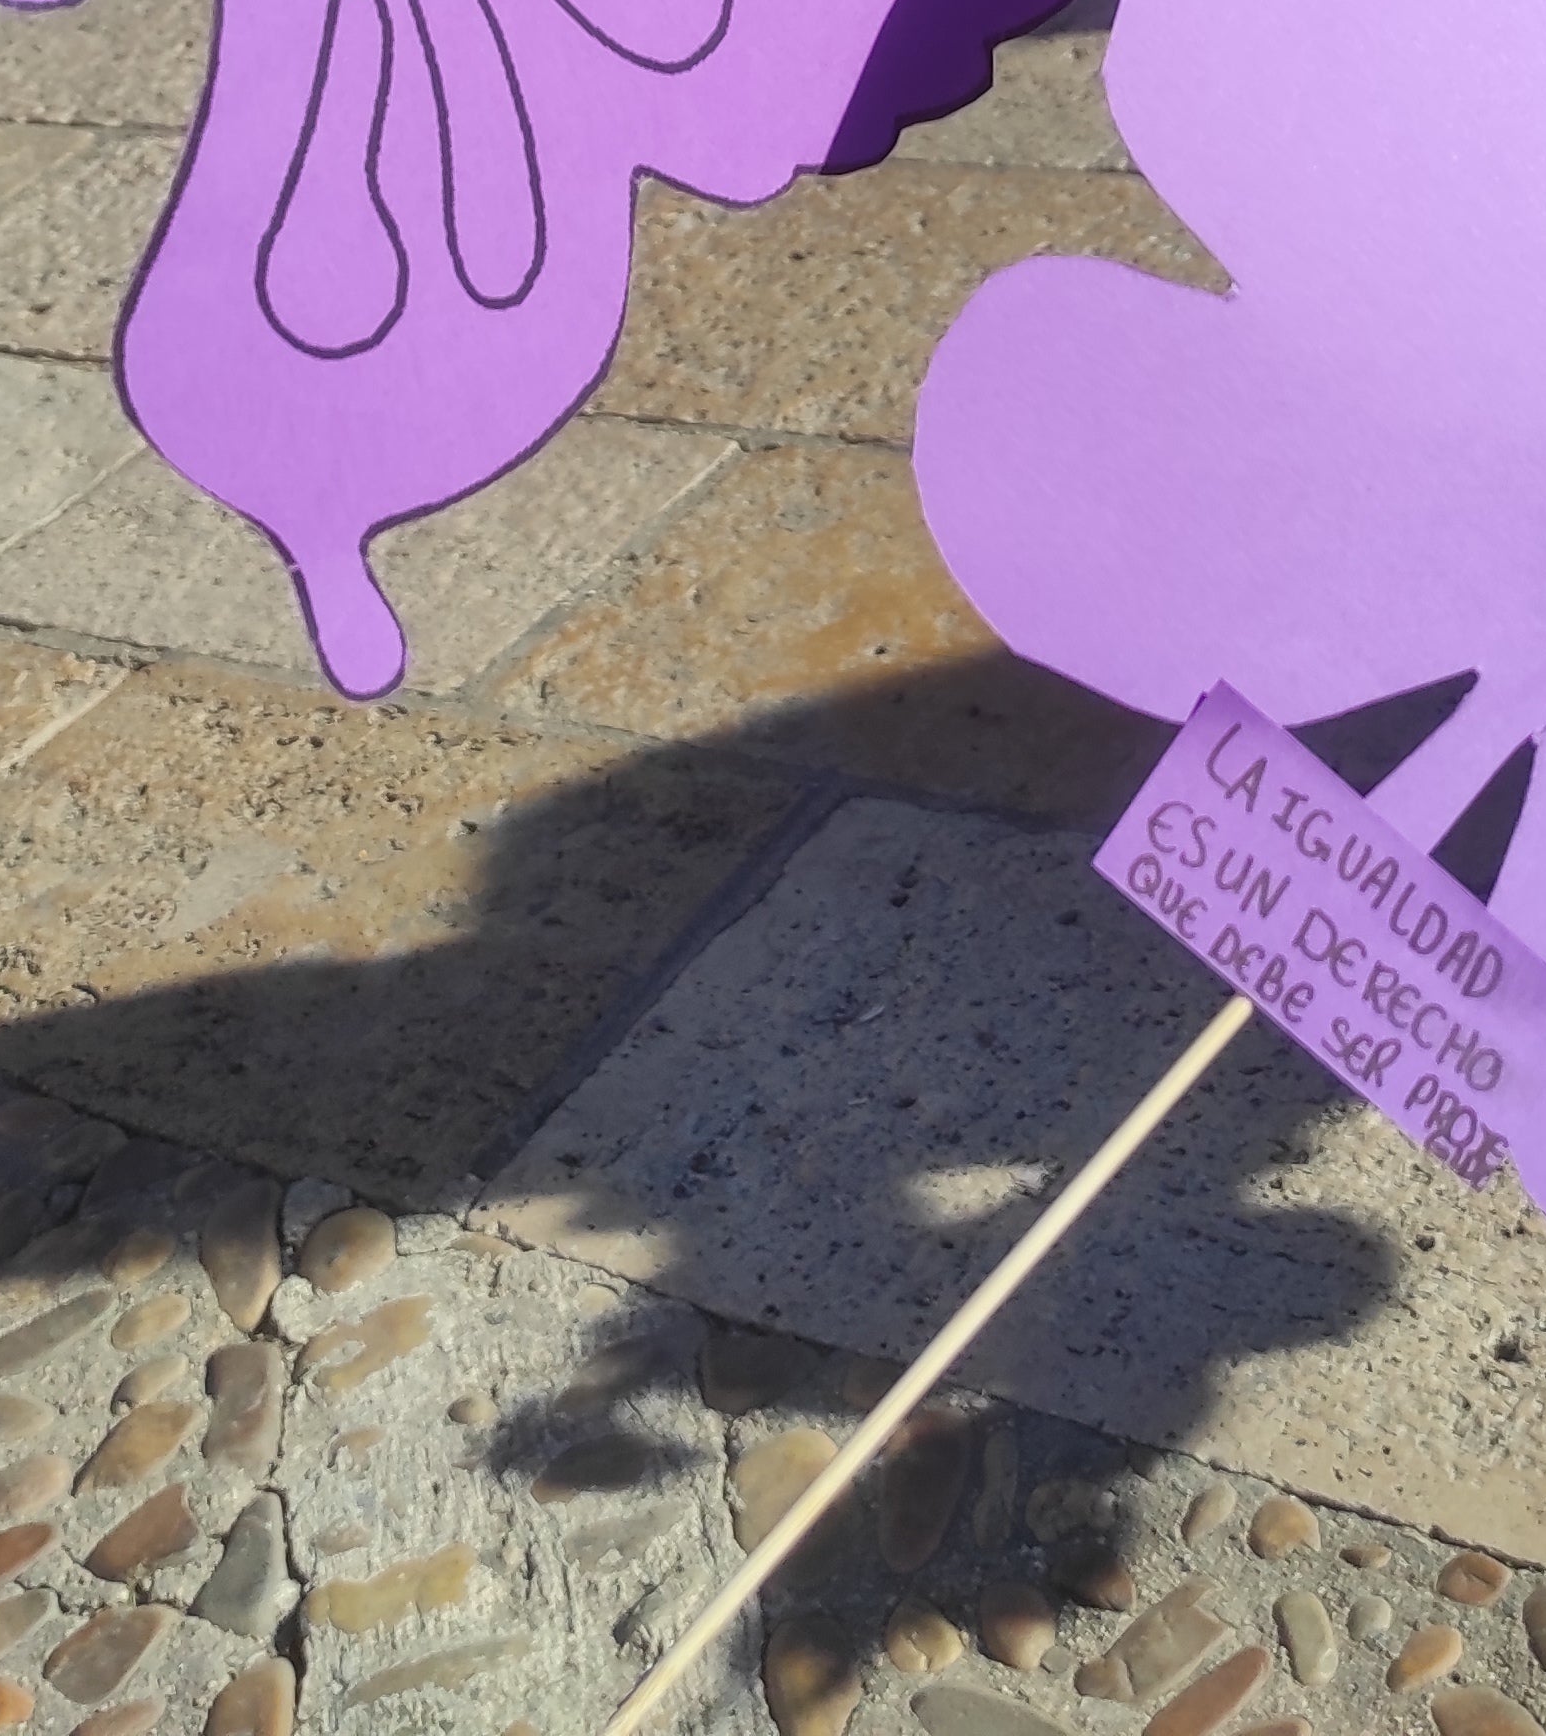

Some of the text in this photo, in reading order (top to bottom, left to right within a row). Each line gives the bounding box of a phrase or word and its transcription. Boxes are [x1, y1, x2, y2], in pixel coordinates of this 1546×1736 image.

[1127, 852, 1209, 940] QUE
[1207, 922, 1315, 1024] DEBE
[1320, 1016, 1402, 1088] SER
[1146, 800, 1505, 1093] ES UN DERECHO
[1205, 721, 1504, 999] LA IGUALDAD
